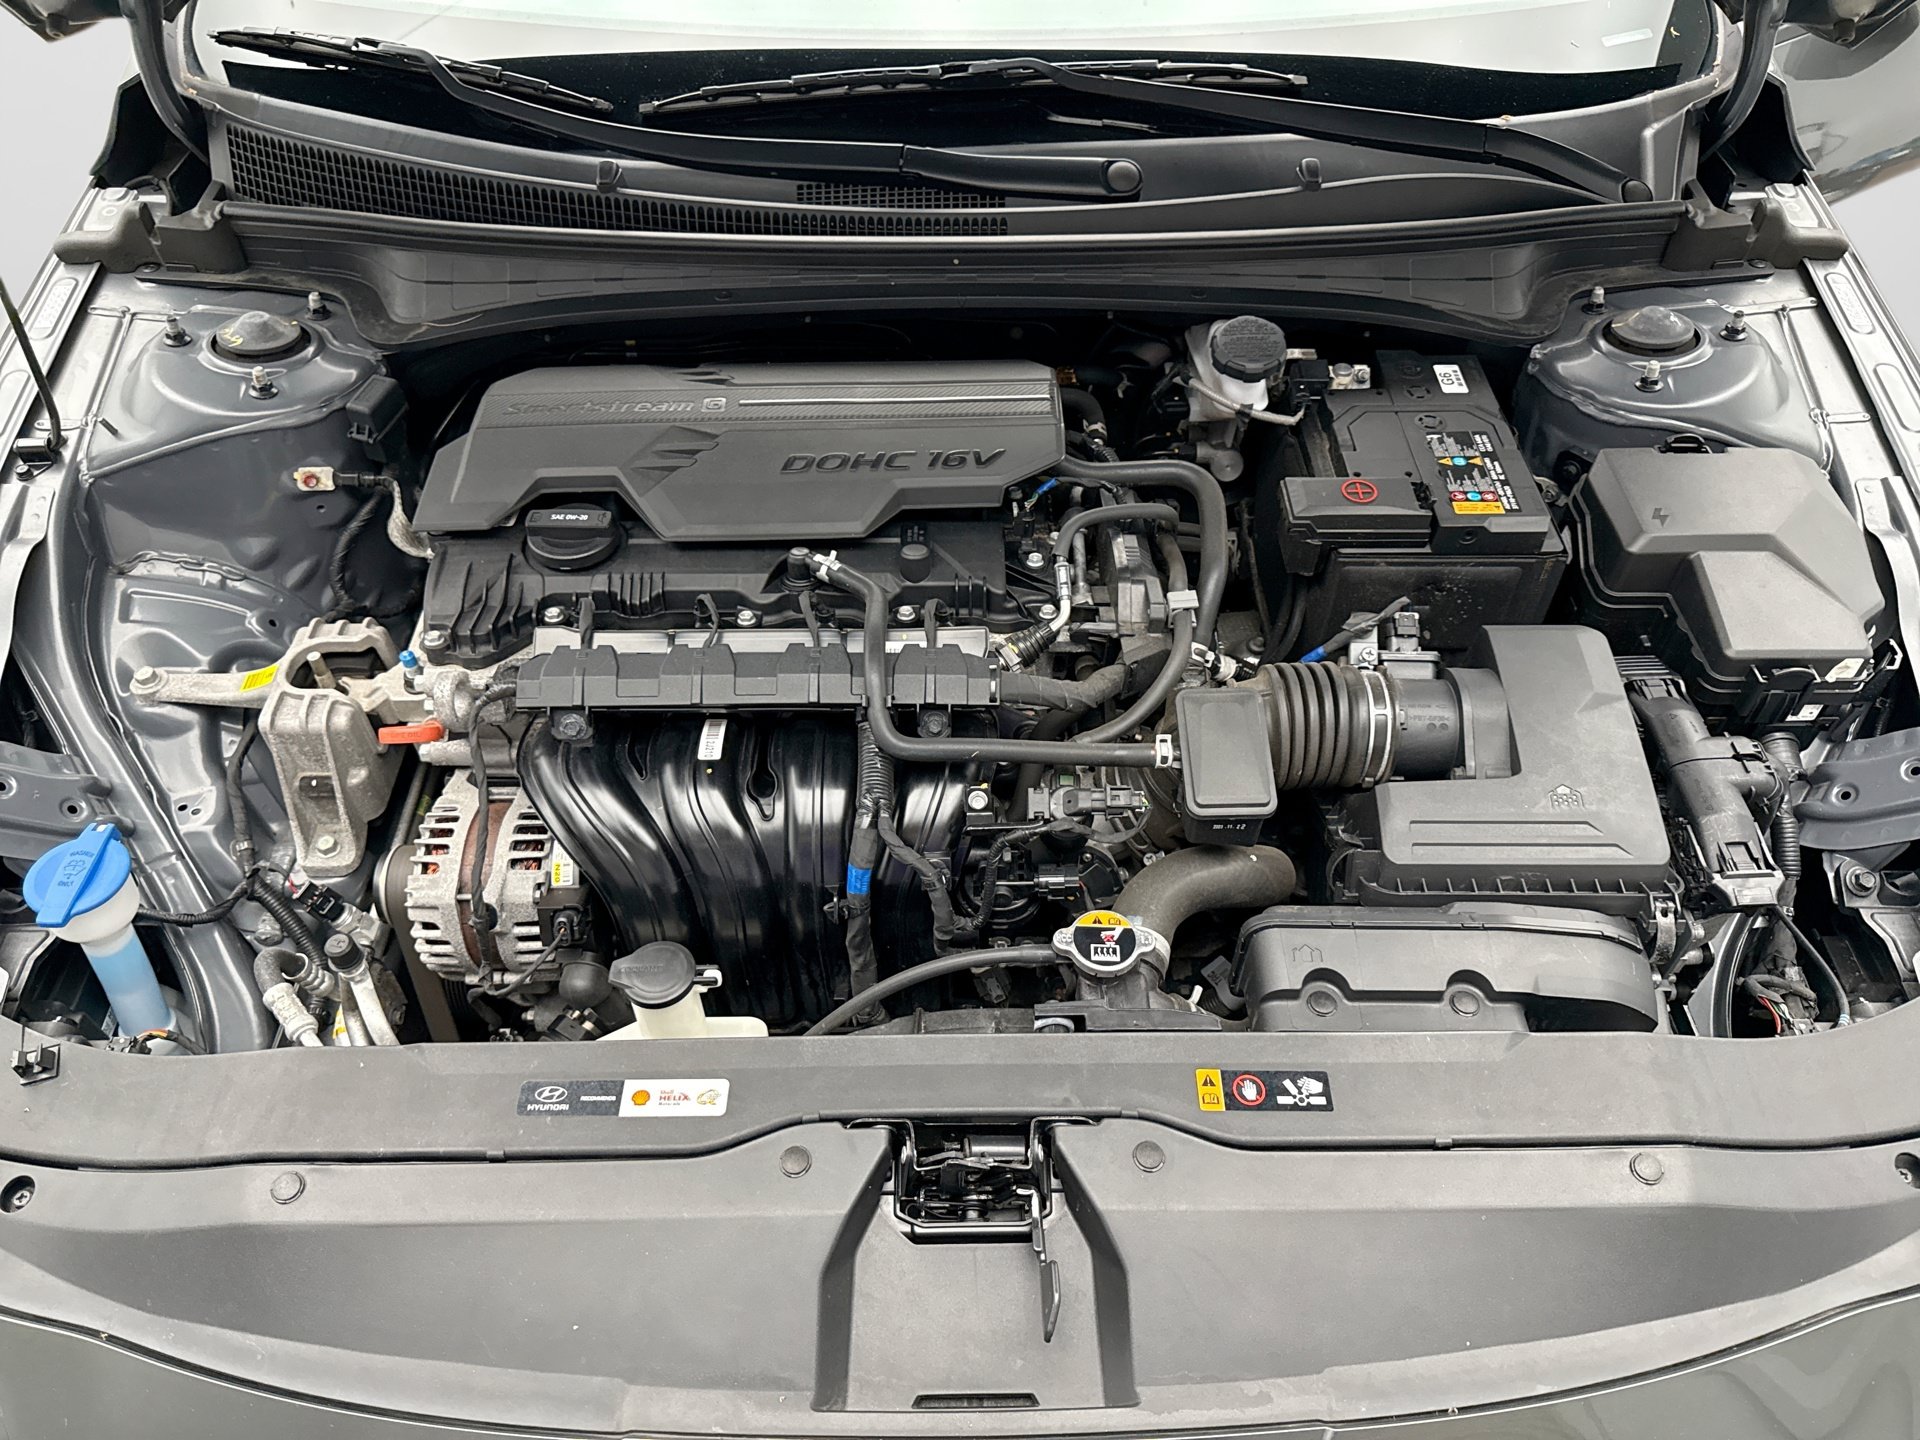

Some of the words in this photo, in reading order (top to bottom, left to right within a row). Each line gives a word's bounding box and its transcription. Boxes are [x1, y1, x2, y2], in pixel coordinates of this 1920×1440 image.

[1439, 372, 1455, 386] G6
[780, 450, 917, 475] DOHC
[928, 449, 1007, 470] 16V
[70, 850, 95, 858] WASHER
[526, 1103, 570, 1111] HYUNDAI
